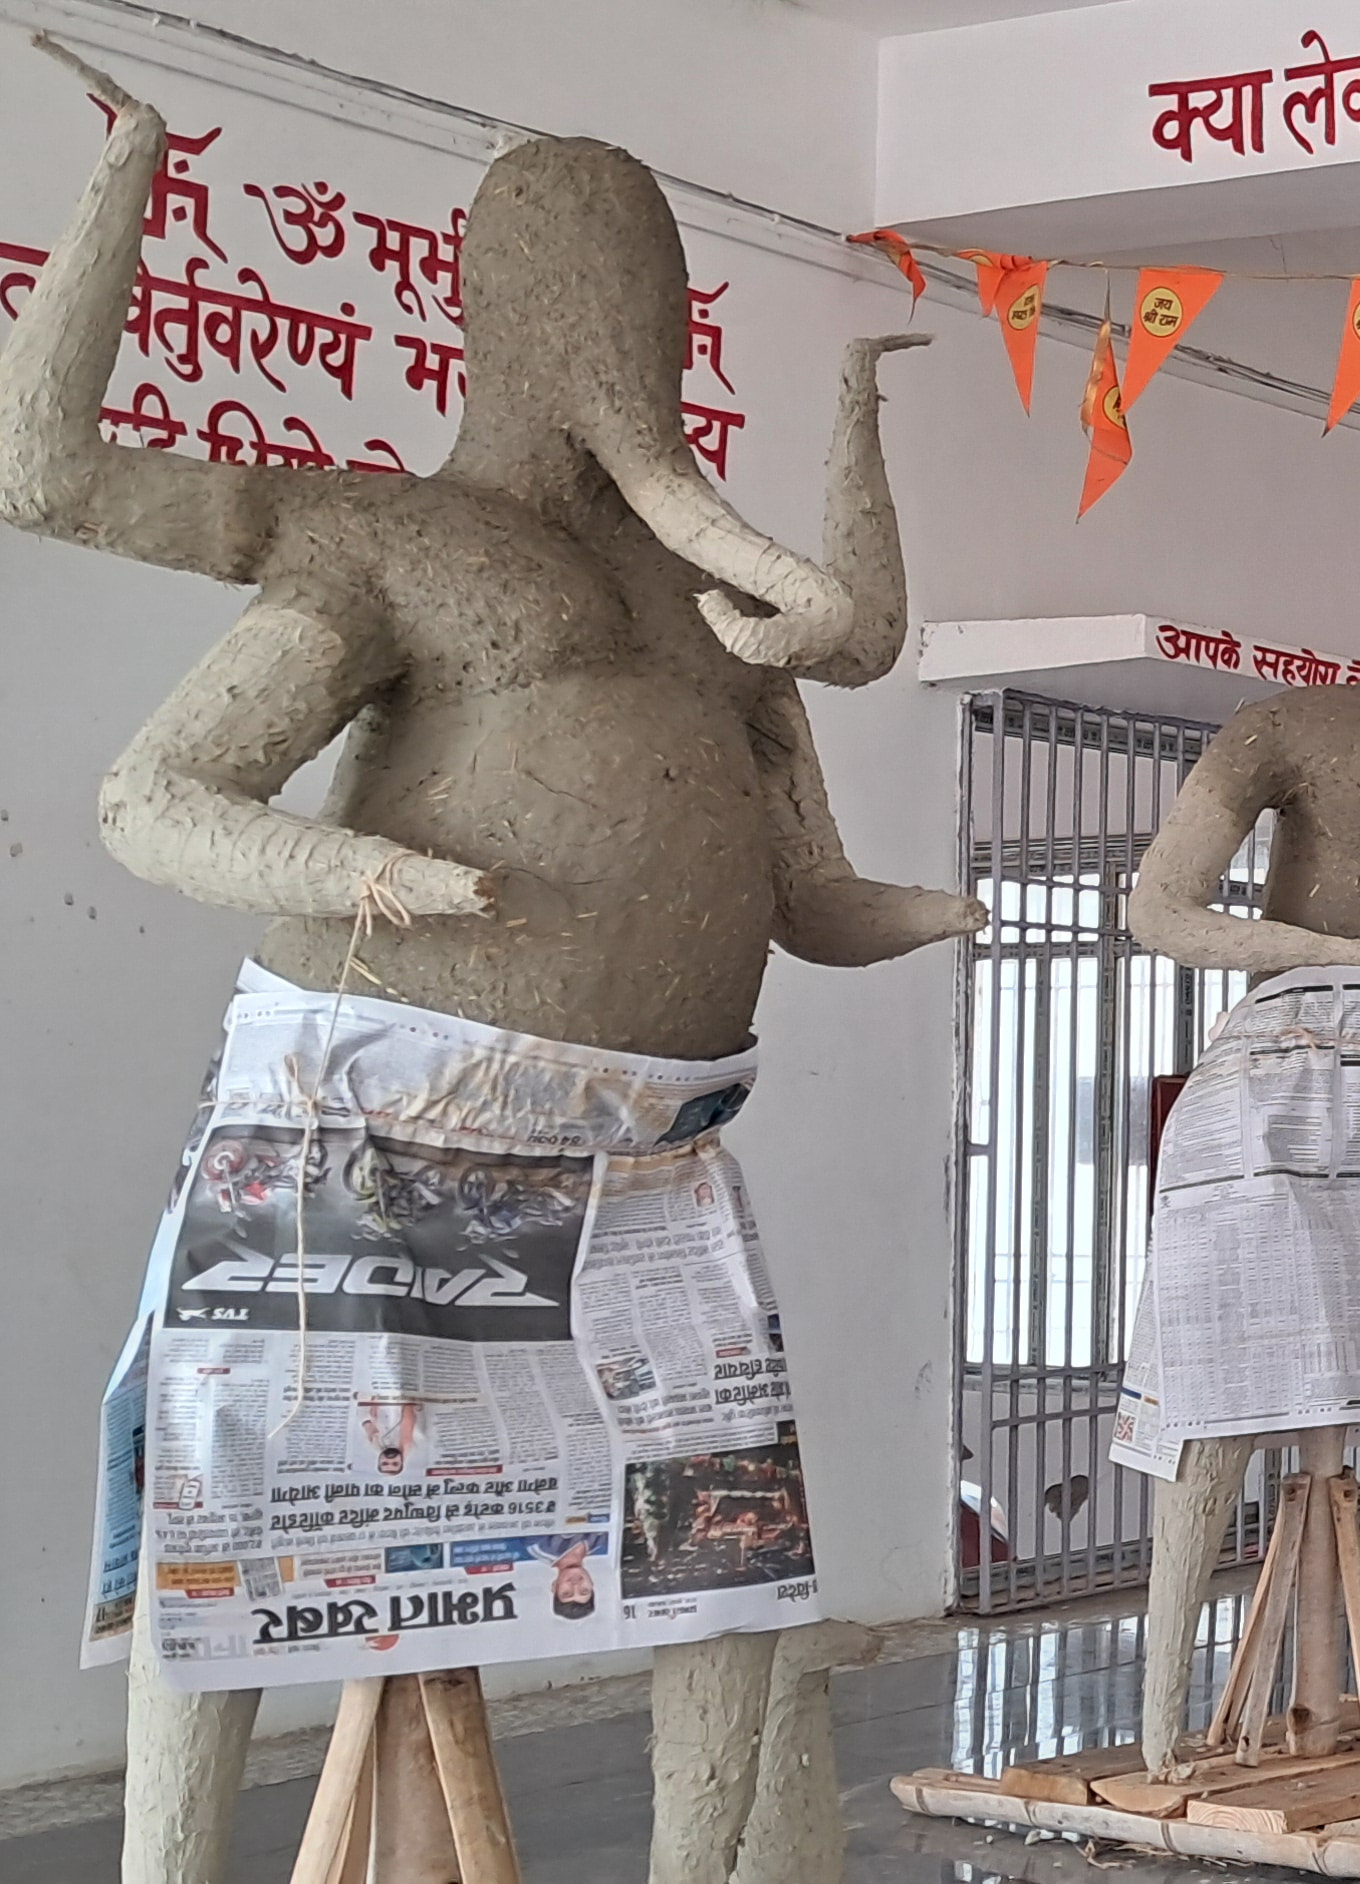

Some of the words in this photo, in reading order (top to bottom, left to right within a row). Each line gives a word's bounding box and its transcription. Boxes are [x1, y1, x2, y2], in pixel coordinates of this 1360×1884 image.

[1149, 68, 1273, 162] क्या
[1155, 298, 1173, 310] जय
[1143, 309, 1157, 323] श्री
[1159, 314, 1178, 327] राम
[1155, 623, 1243, 670] आपके
[181, 1243, 561, 1307] RAIDER
[211, 1307, 249, 1321] TVS
[269, 1485, 320, 1504] आयेगा
[324, 1483, 361, 1504] पानी
[364, 1483, 384, 1498] का
[387, 1482, 423, 1500] सोन
[426, 1482, 440, 1501] में
[485, 1479, 515, 1498] और
[339, 1507, 380, 1527] मंदिर
[445, 1503, 460, 1521] से
[462, 1499, 504, 1520] करोड़
[386, 1581, 518, 1634] प्रभात
[623, 1604, 637, 1620] 16
[251, 1599, 379, 1644] खबर
